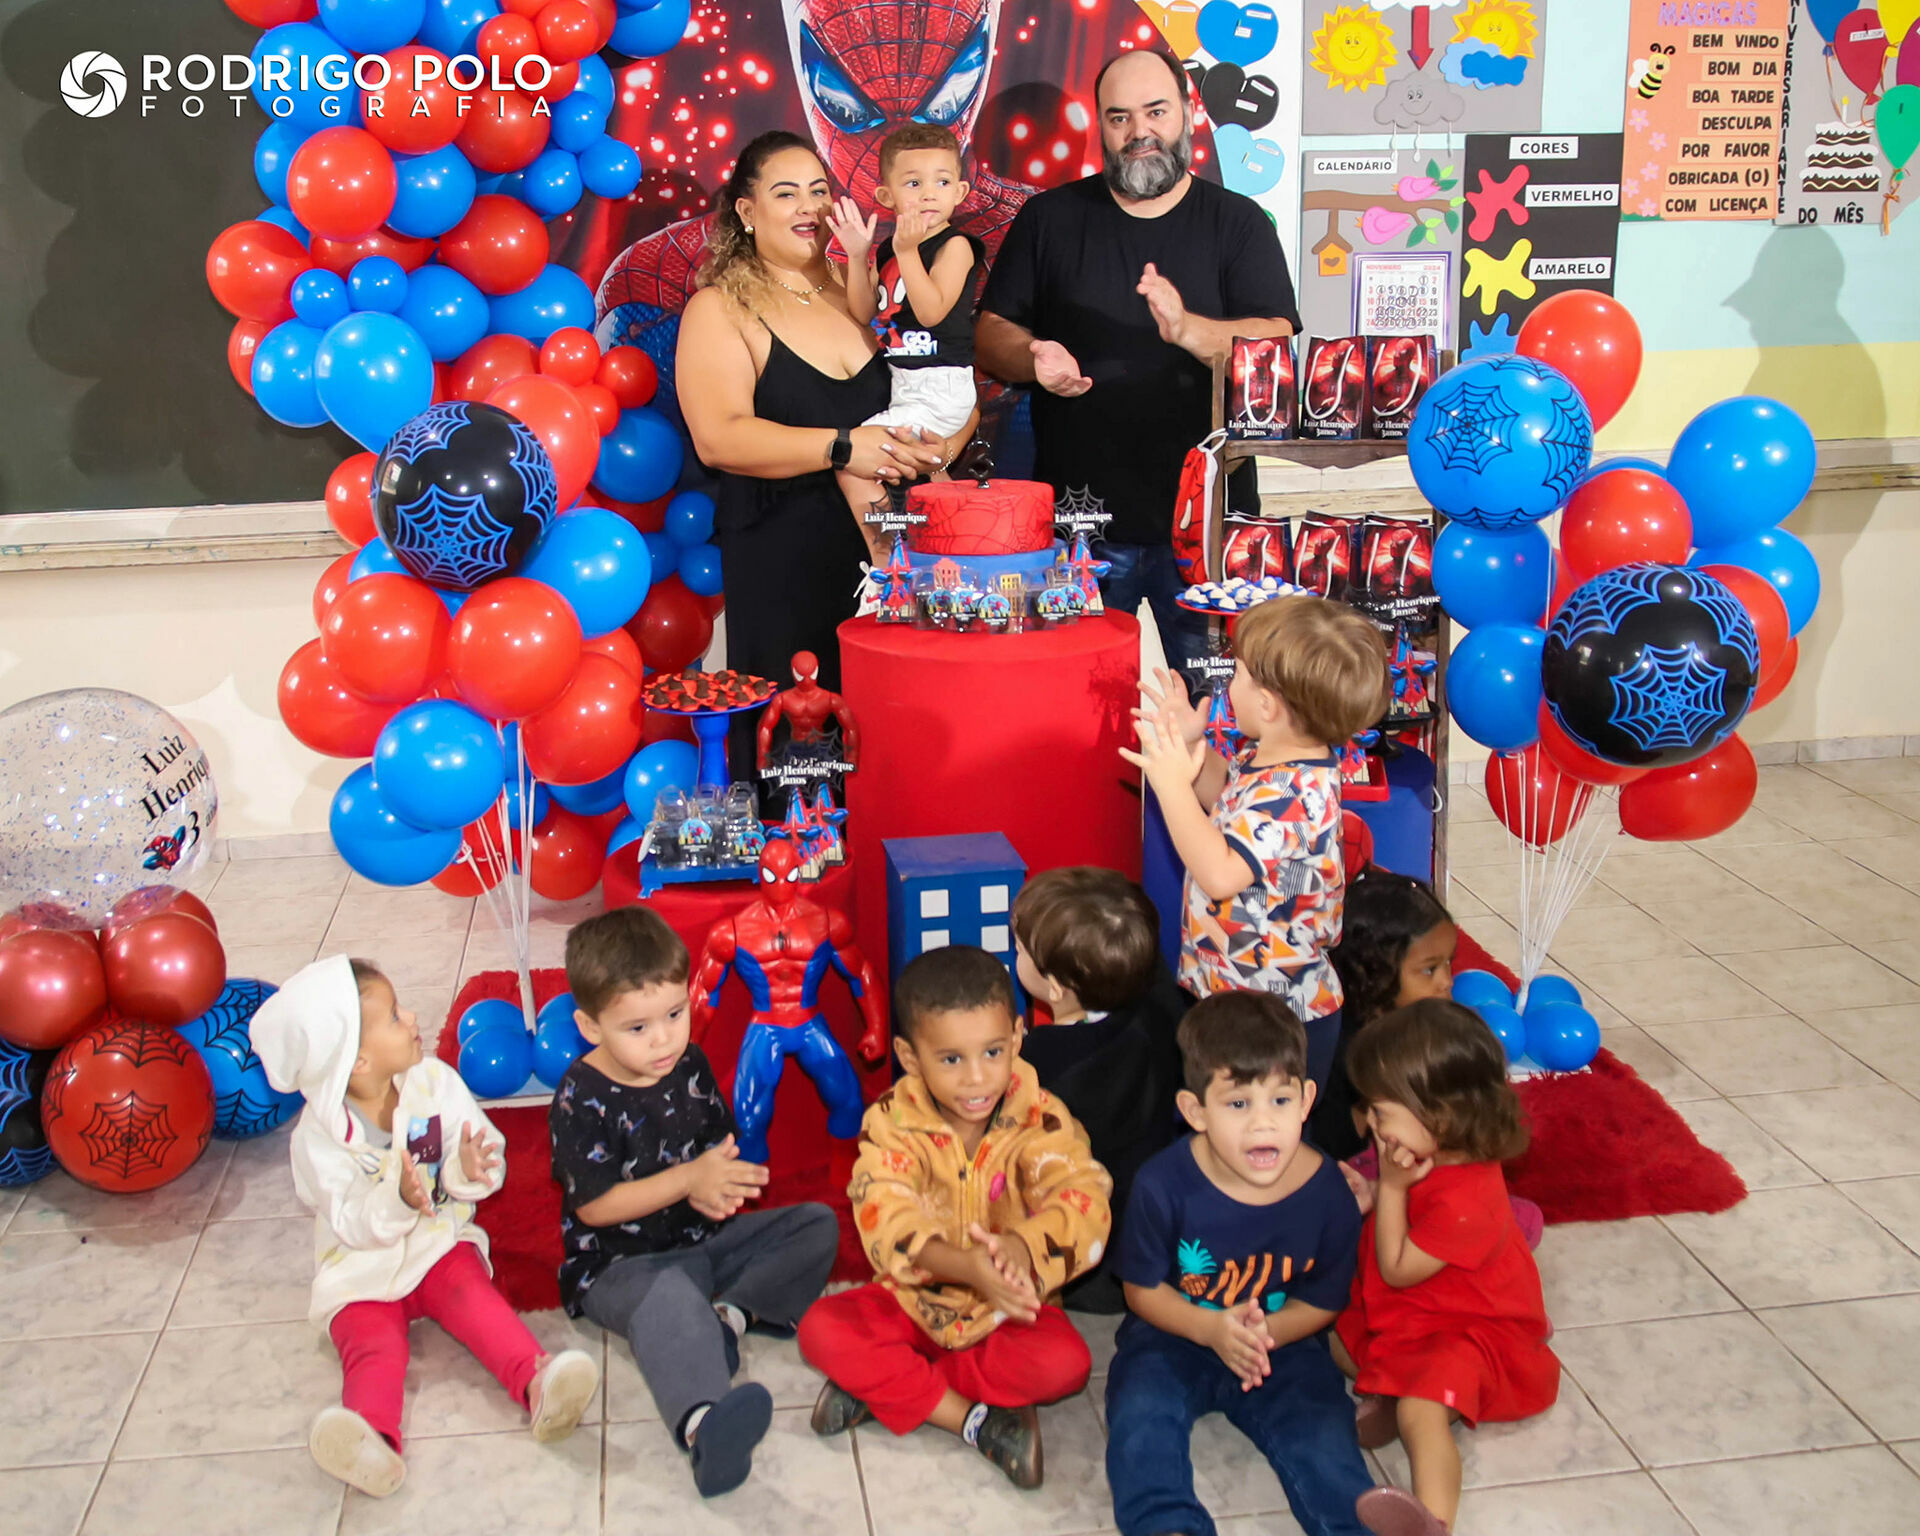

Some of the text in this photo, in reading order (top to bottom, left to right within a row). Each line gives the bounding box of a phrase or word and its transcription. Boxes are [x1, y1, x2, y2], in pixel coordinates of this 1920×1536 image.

[1692, 33, 1780, 49] BEM VINDO
[1707, 61, 1778, 76] BOM DIA
[1692, 89, 1775, 104] BOA TARDE
[1701, 115, 1773, 131] DESCULPA
[1519, 142, 1570, 154] CORES
[1681, 142, 1771, 158] POR FAVOR
[1317, 160, 1393, 171] CALENDÁRIO
[1668, 171, 1740, 186] OBRIGADA
[1531, 189, 1614, 202] VERMELHO
[1665, 196, 1769, 214] COM LICENÇA
[1798, 201, 1865, 225] DO MÊS
[1534, 263, 1606, 276] AMARELO
[1429, 297, 1438, 306] 16
[1428, 308, 1438, 317] 23
[1228, 419, 1246, 428] Luiz
[1304, 419, 1356, 430] Luiz Henrique
[864, 511, 928, 524] Luiz Henrique
[1054, 511, 1113, 523] Luiz Henrique
[1395, 595, 1441, 608] Henrique
[1186, 656, 1209, 668] Luiz
[140, 735, 188, 776] Luiz
[760, 764, 829, 779] Luiz Henrique
[138, 758, 210, 822] Henriq
[187, 810, 201, 850] 3
